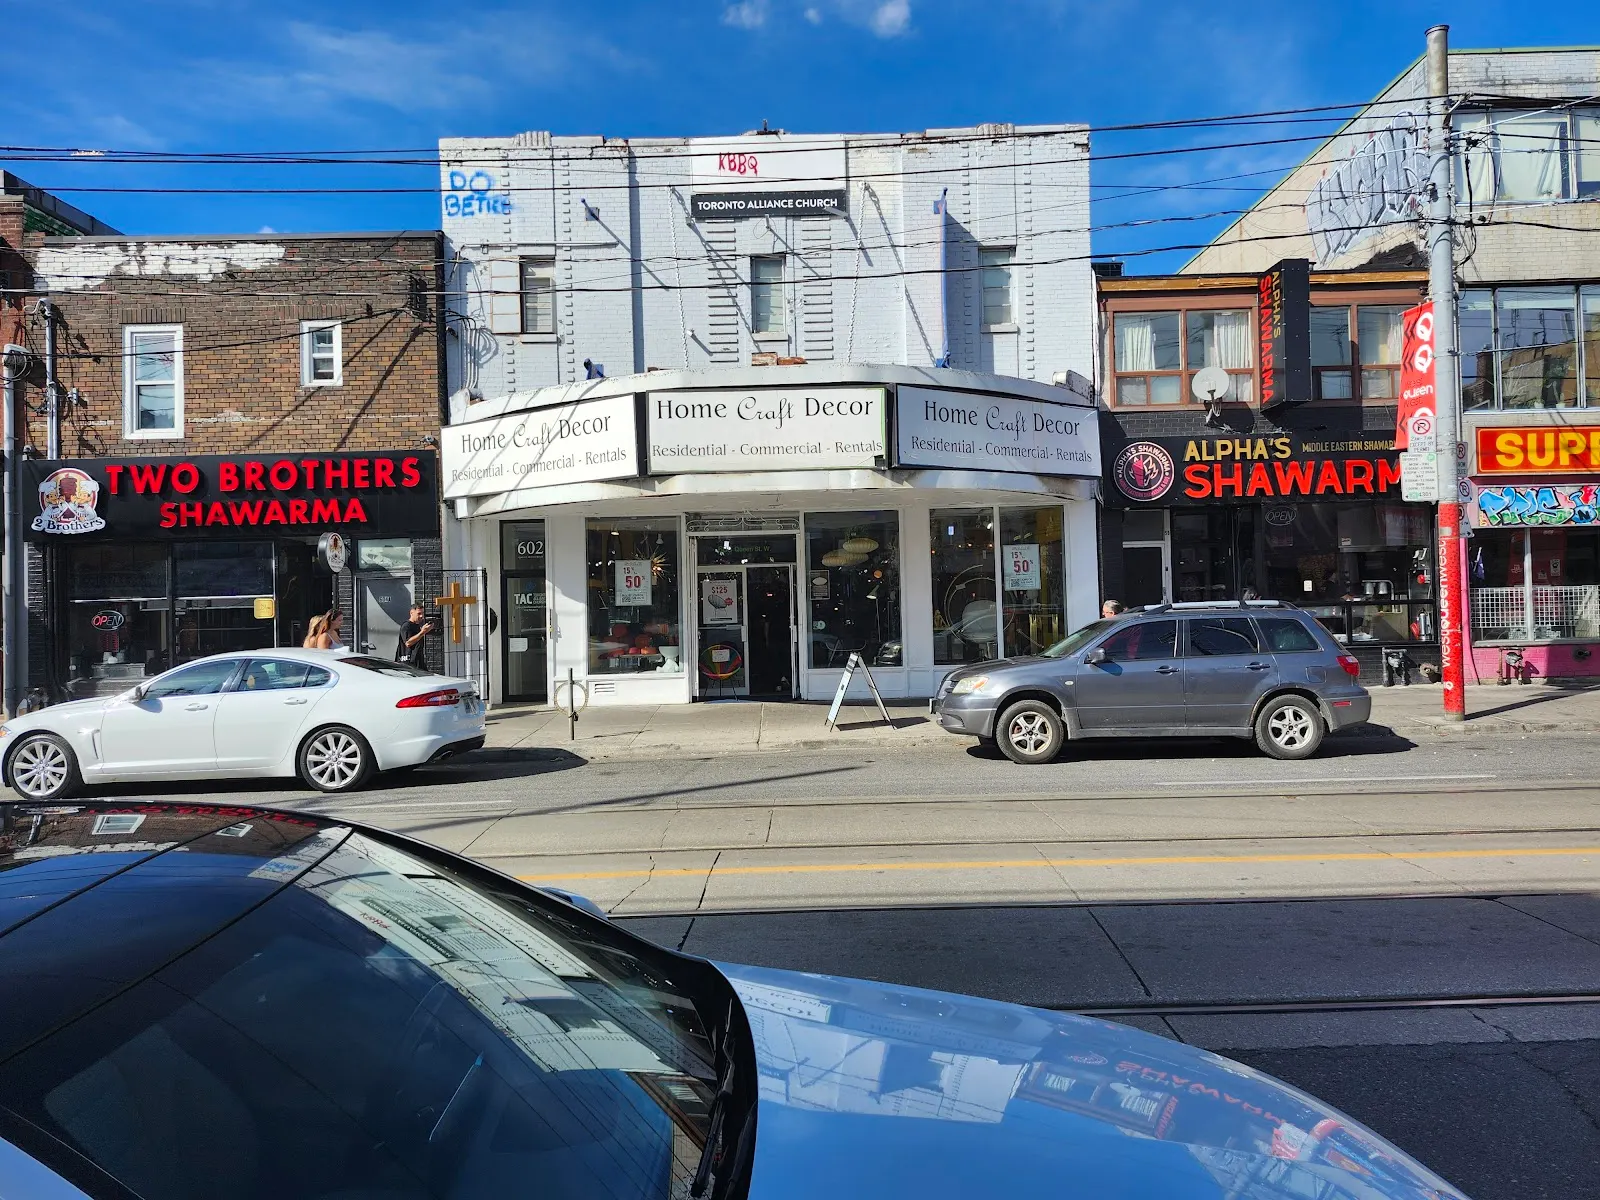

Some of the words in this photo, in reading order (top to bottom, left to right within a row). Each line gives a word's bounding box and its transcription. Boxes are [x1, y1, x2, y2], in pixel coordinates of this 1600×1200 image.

[718, 152, 758, 176] KBBQ
[449, 170, 492, 196] DO
[697, 201, 745, 211] TORONTO
[747, 199, 793, 209] ALLIANCE
[795, 197, 838, 208] CHURCH
[1271, 270, 1281, 339] ALPHA'S
[1259, 274, 1275, 405] SHAWARMA
[657, 400, 727, 419] Home
[737, 396, 795, 428] Craft
[805, 397, 875, 417] Decor
[924, 400, 978, 426] Home
[986, 405, 1028, 441] Craft
[1033, 412, 1080, 436] Decor
[461, 430, 506, 454] Home
[512, 421, 552, 455] Craft
[558, 414, 612, 440] Decor
[1302, 443, 1330, 452] MIDDLE
[1331, 441, 1363, 452] EASTERN
[1364, 440, 1397, 450] SHAWAR
[652, 443, 727, 456] Residential
[739, 442, 822, 456] Commercial
[835, 440, 883, 453] Rentals
[911, 436, 976, 454] Residential
[985, 442, 1049, 460] Commercial
[1056, 449, 1093, 463] Rentals
[1117, 447, 1137, 474] ALPHA'S
[1138, 445, 1171, 472] SHAWARMA
[1183, 437, 1291, 462] ALPHA'S
[105, 463, 200, 495] TWO
[219, 457, 421, 492] BROTHERS
[451, 463, 504, 482] Residential
[512, 457, 575, 476] Commercial
[585, 447, 627, 465] Rentals
[1183, 458, 1401, 498] SHAWARM
[34, 518, 43, 527] 2
[47, 518, 103, 531] Brothers
[160, 497, 368, 528] SHAWARMA
[1266, 511, 1293, 521] OPEN
[517, 541, 544, 555] 602
[513, 593, 533, 605] TAC
[92, 614, 121, 627] OPEN
